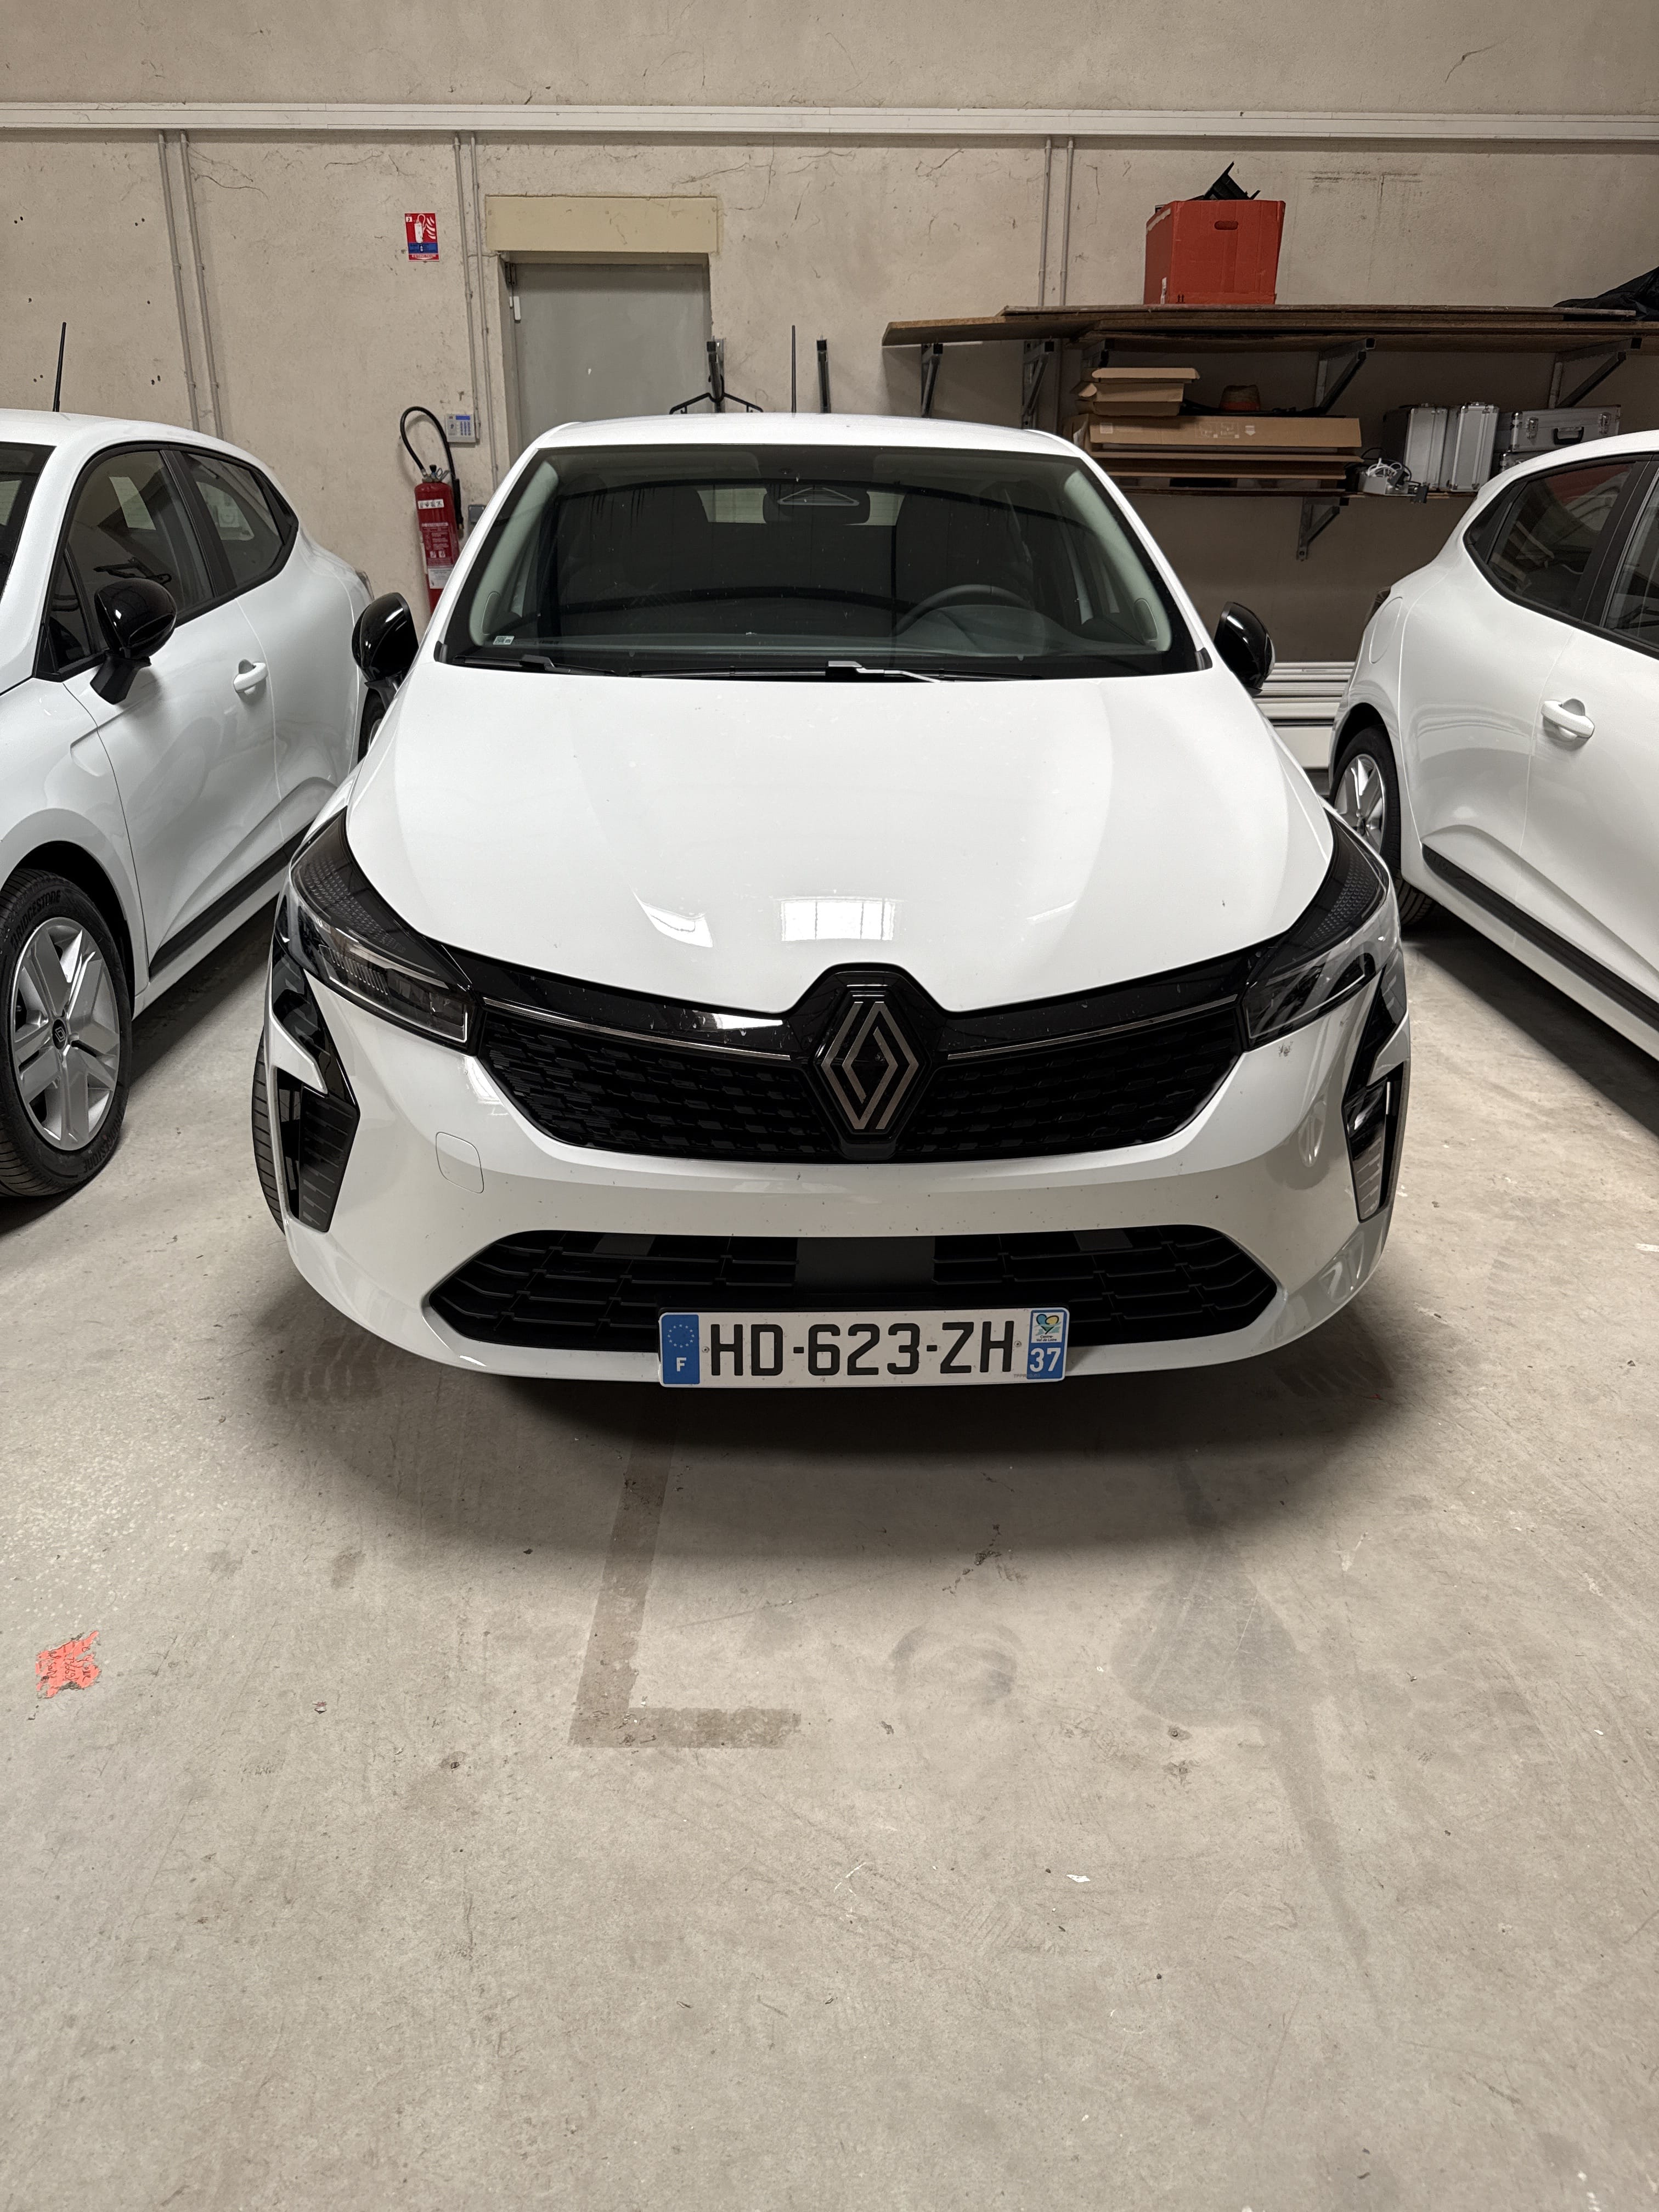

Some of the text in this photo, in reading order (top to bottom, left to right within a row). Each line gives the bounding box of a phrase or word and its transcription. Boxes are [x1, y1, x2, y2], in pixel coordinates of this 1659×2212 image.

[711, 1321, 1014, 1376] HD-623-ZH
[1030, 1347, 1061, 1372] 37
[676, 1357, 686, 1372] F
